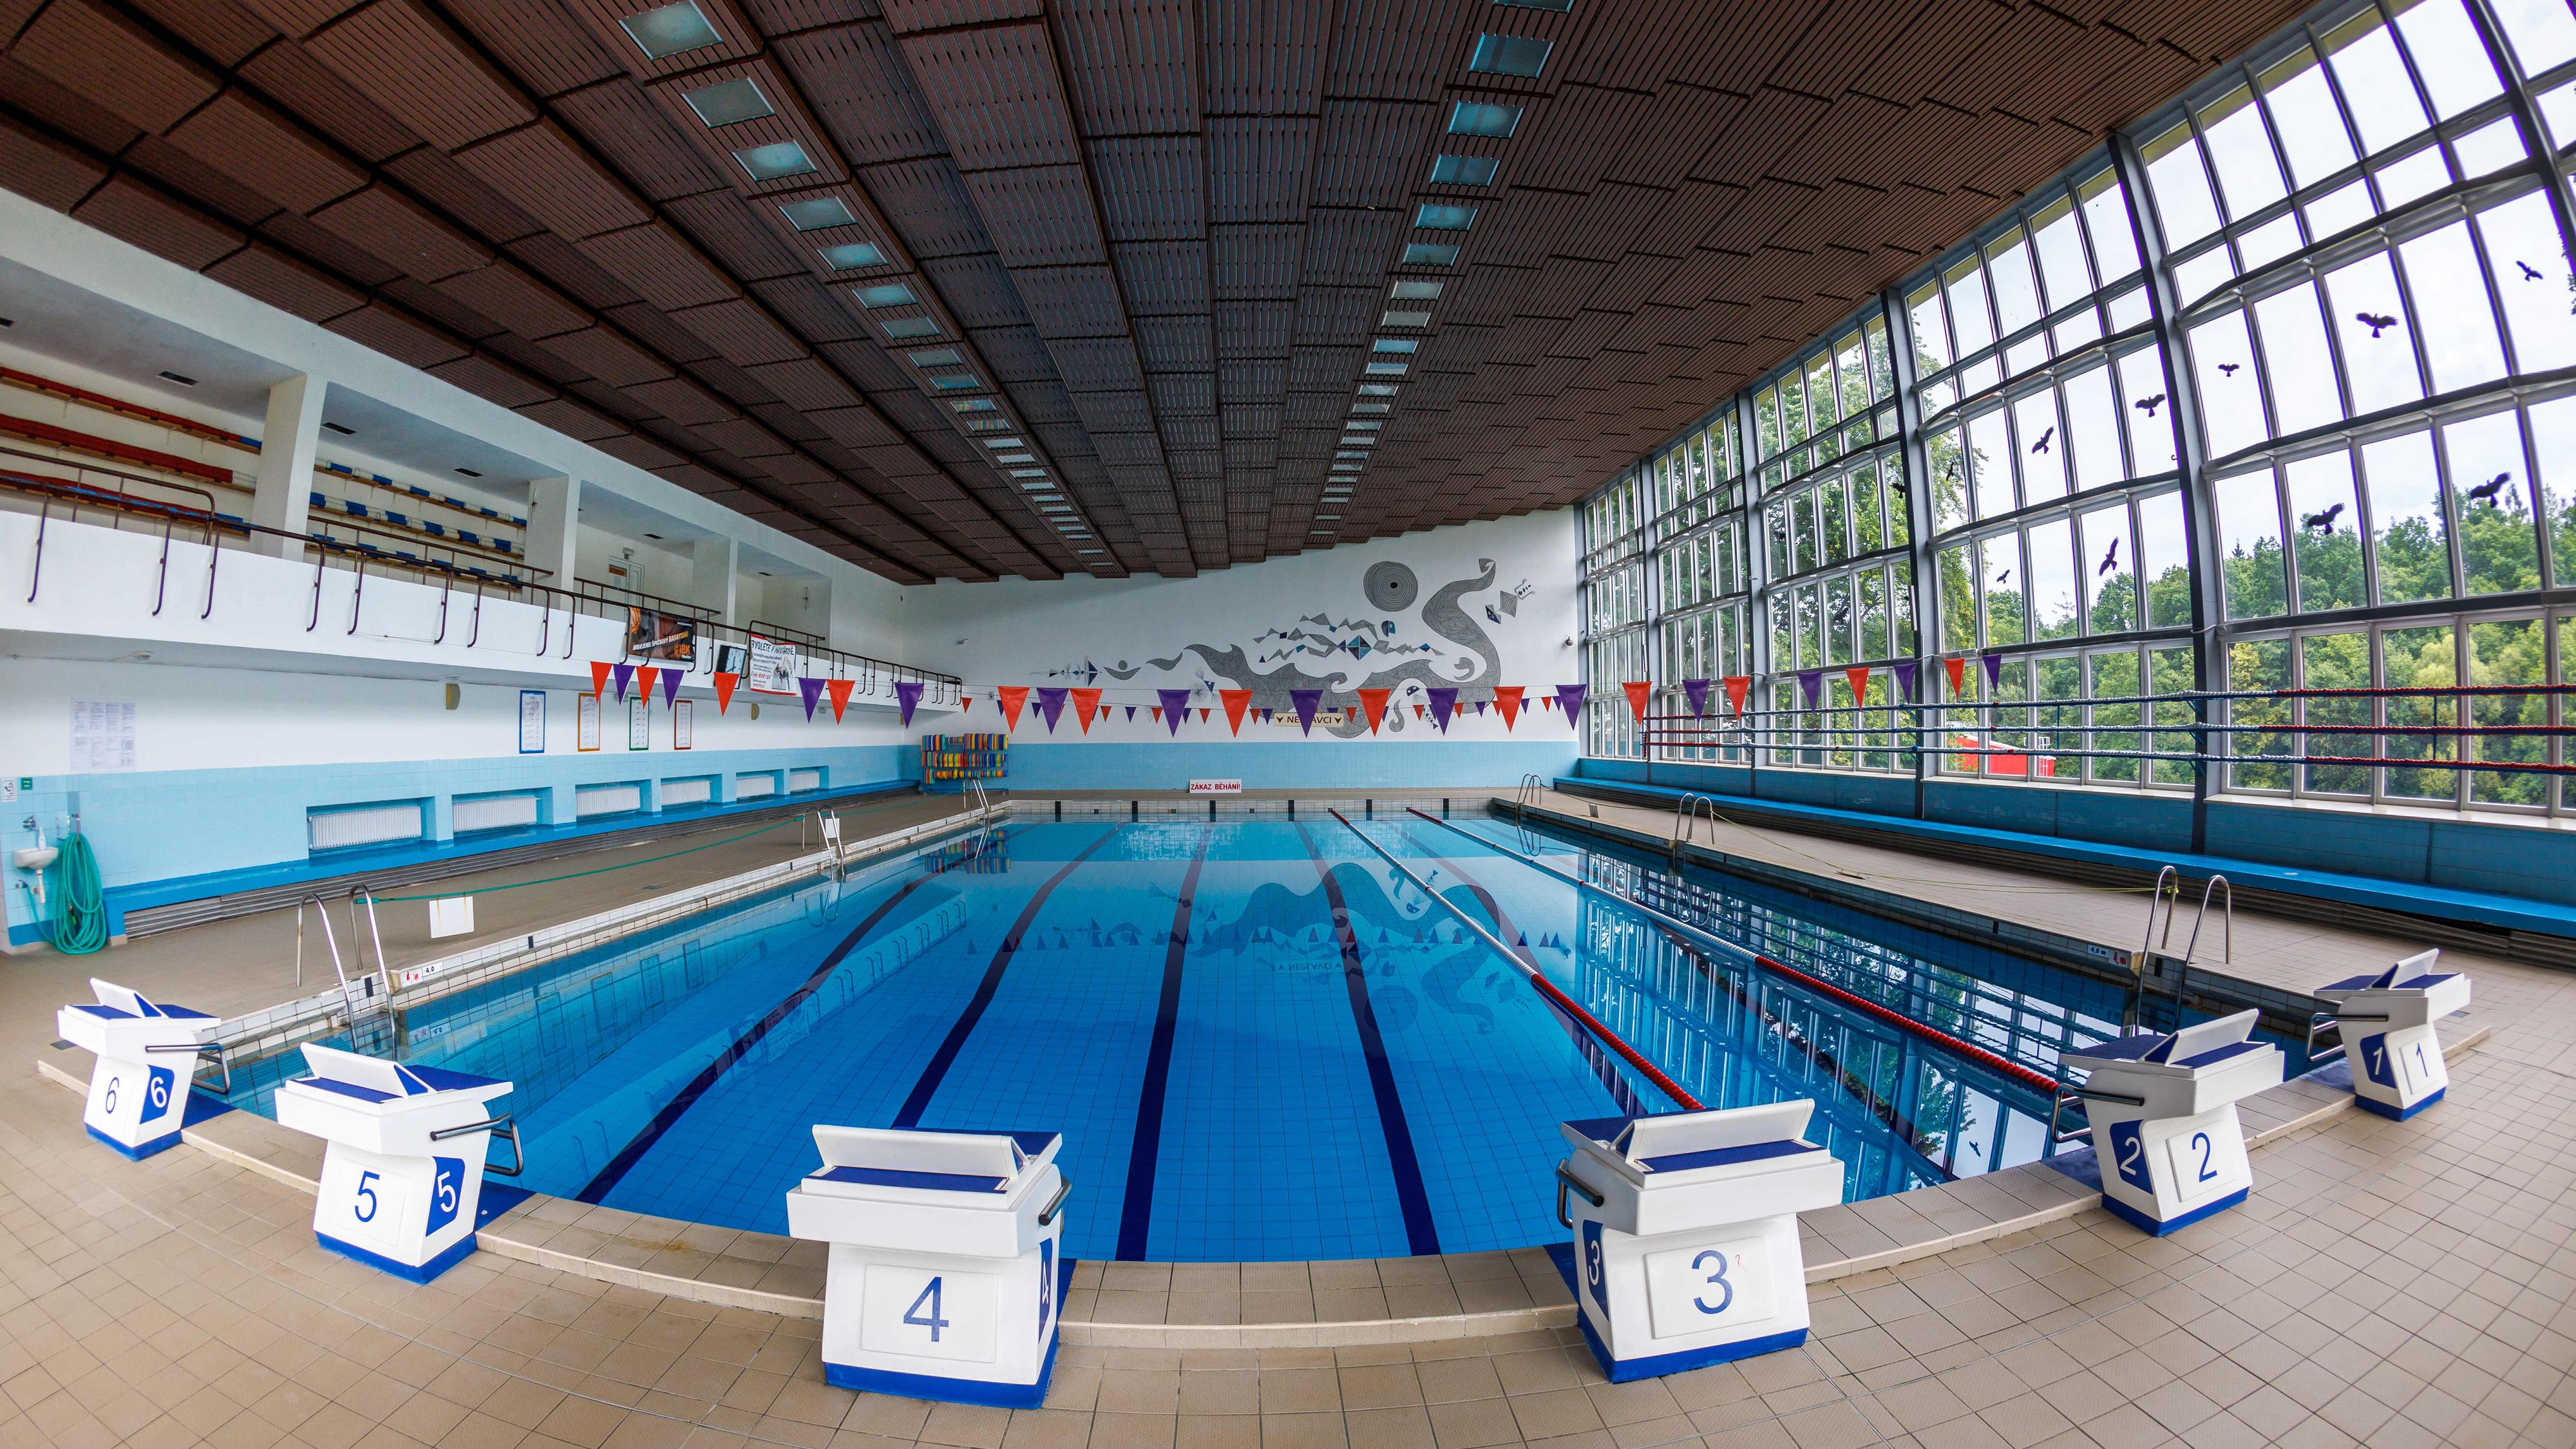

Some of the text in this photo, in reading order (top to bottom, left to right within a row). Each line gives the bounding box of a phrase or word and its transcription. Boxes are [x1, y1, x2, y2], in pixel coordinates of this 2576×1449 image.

[1191, 782, 1240, 790] ZÁKAZ BĚHÁNÍ!
[2372, 1046, 2383, 1075] 1
[2416, 1043, 2429, 1077] 1
[105, 1076, 120, 1115] 6
[150, 1076, 167, 1108] 6
[2119, 1137, 2141, 1176] 2
[2192, 1132, 2217, 1182] 2
[354, 1170, 380, 1223] 5
[437, 1171, 456, 1213] 5
[1042, 1261, 1049, 1305] 4
[1588, 1240, 1600, 1286] 3
[1692, 1249, 1733, 1314] 3
[903, 1276, 949, 1343] 4
